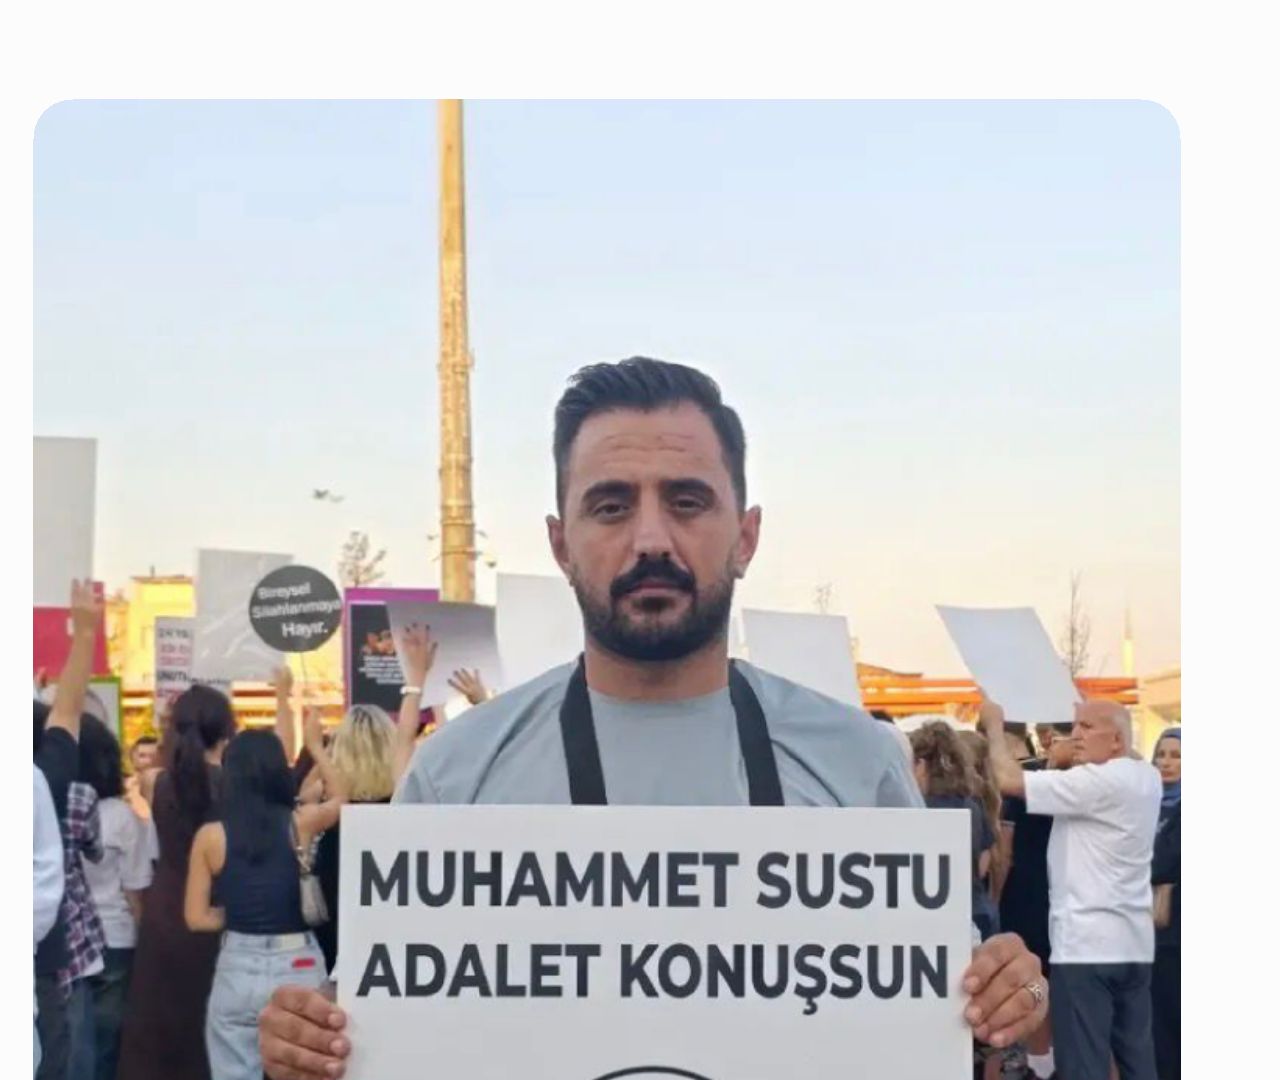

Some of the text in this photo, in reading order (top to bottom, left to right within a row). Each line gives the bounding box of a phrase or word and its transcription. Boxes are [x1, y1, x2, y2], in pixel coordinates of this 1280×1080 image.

[258, 582, 311, 599] Bireysel
[359, 850, 951, 910] MUHAMMET SUSTU
[355, 942, 949, 1016] ADALET KONUŞSUN
